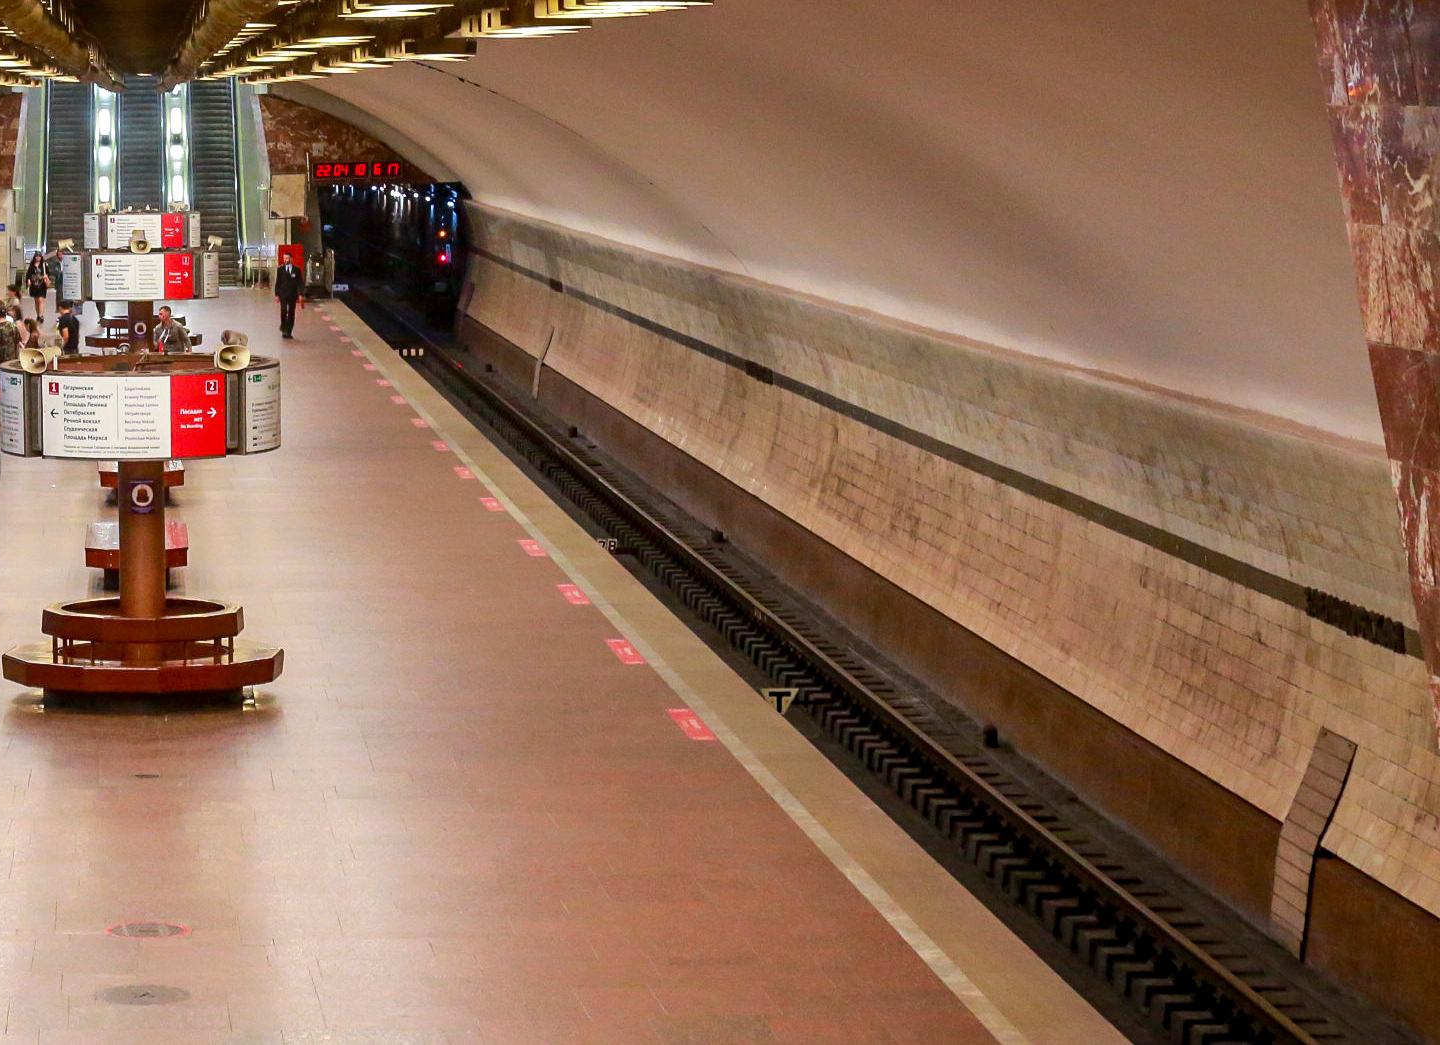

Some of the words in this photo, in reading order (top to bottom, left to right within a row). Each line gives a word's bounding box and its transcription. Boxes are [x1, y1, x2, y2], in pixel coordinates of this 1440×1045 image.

[316, 164, 331, 177] 22
[333, 164, 348, 176] 04
[355, 163, 366, 176] 10
